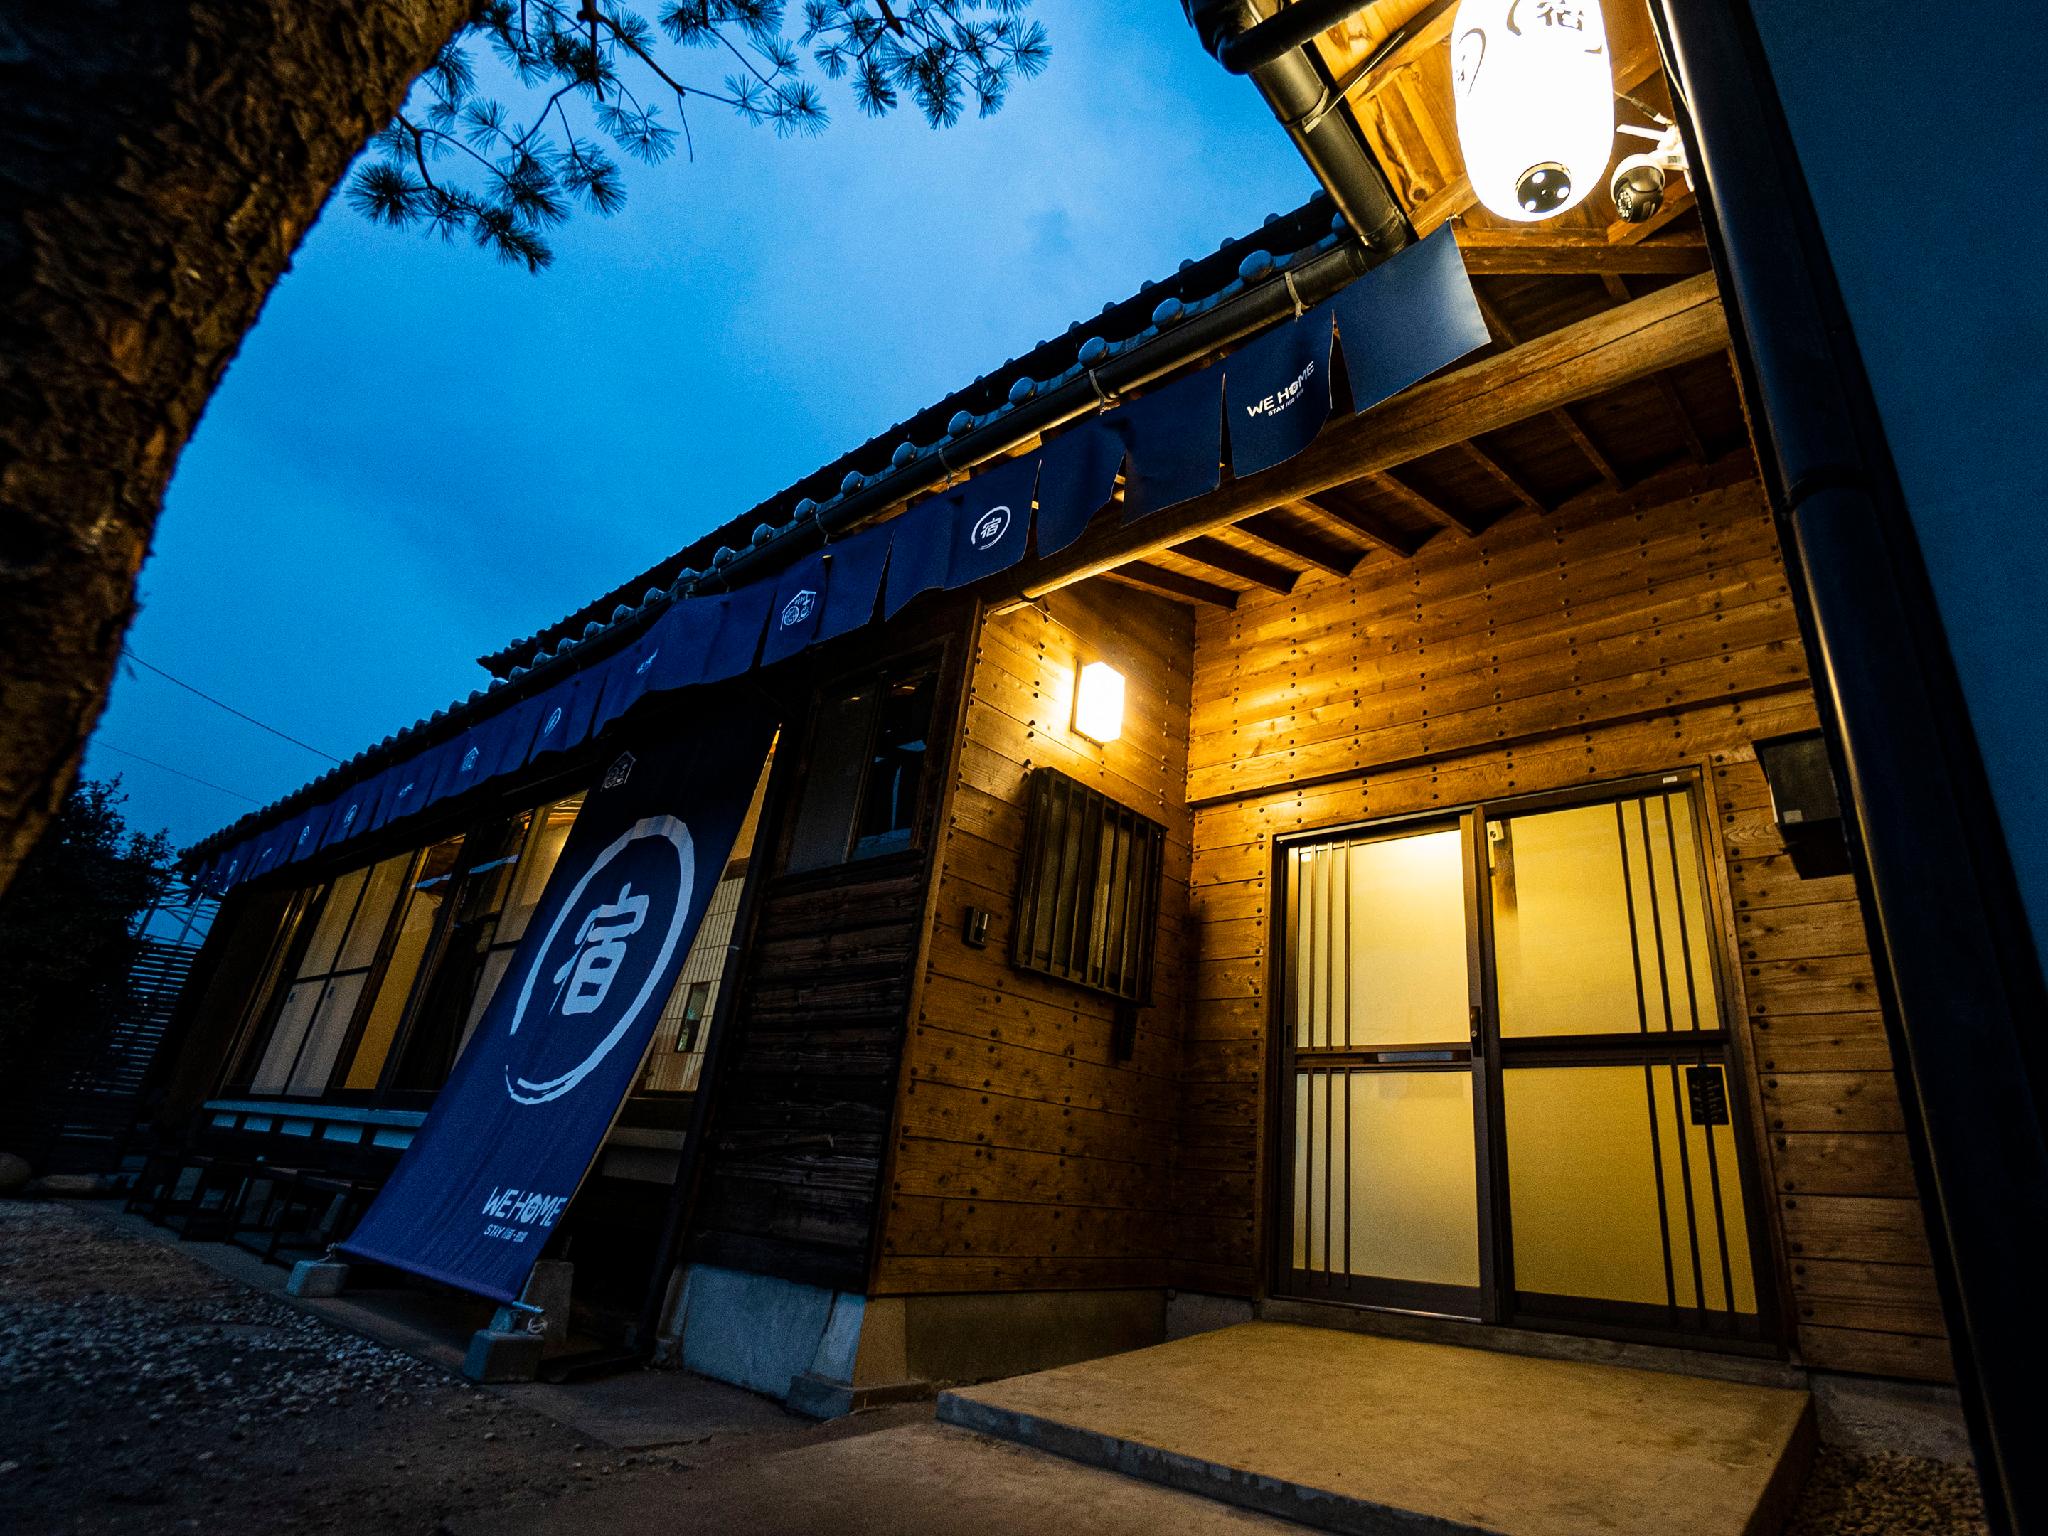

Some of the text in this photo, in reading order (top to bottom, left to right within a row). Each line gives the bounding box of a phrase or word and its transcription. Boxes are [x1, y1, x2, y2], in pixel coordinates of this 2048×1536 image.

[1246, 395, 1275, 417] WE
[1277, 360, 1314, 404] HOME
[548, 881, 650, 1015] 宿
[482, 1186, 568, 1228] WE HOME
